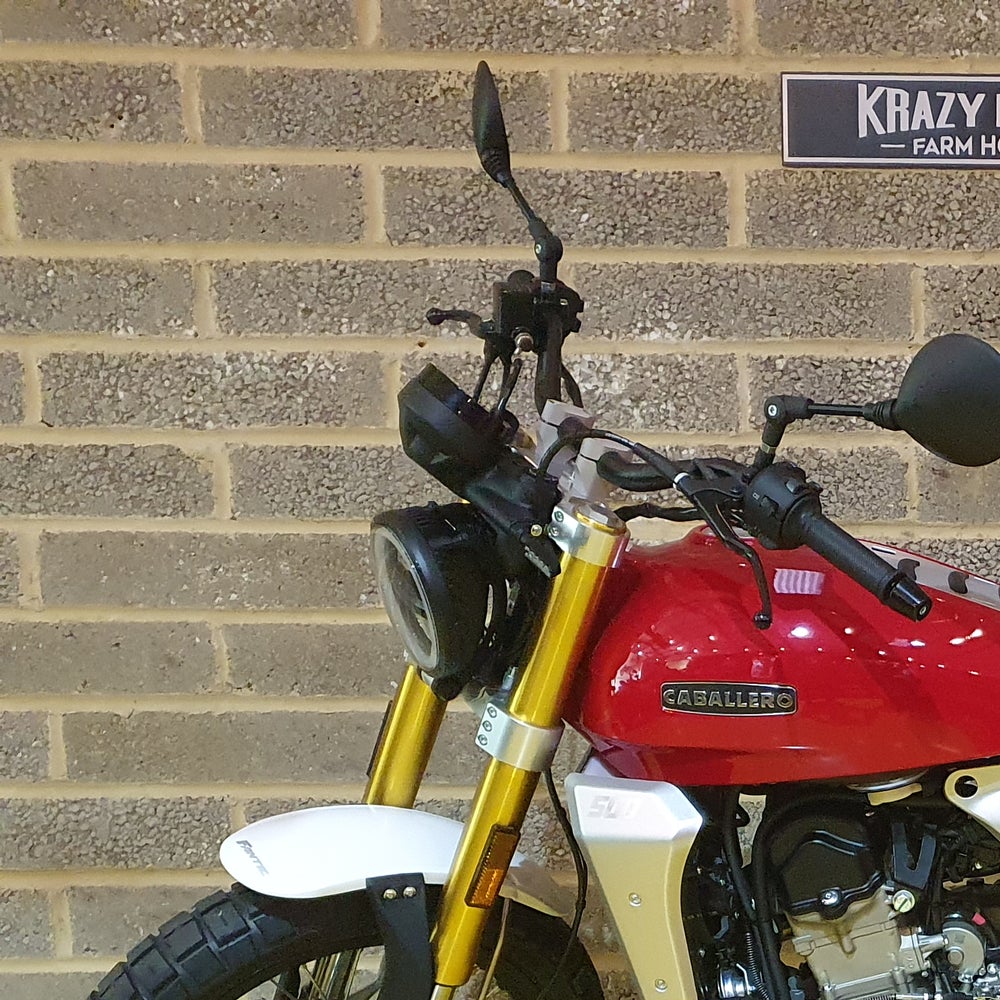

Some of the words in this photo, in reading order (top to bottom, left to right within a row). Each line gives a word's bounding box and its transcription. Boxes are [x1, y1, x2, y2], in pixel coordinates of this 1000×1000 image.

[857, 83, 986, 138] KRAZY
[913, 135, 973, 156] FARM
[662, 688, 794, 709] CABALLERO
